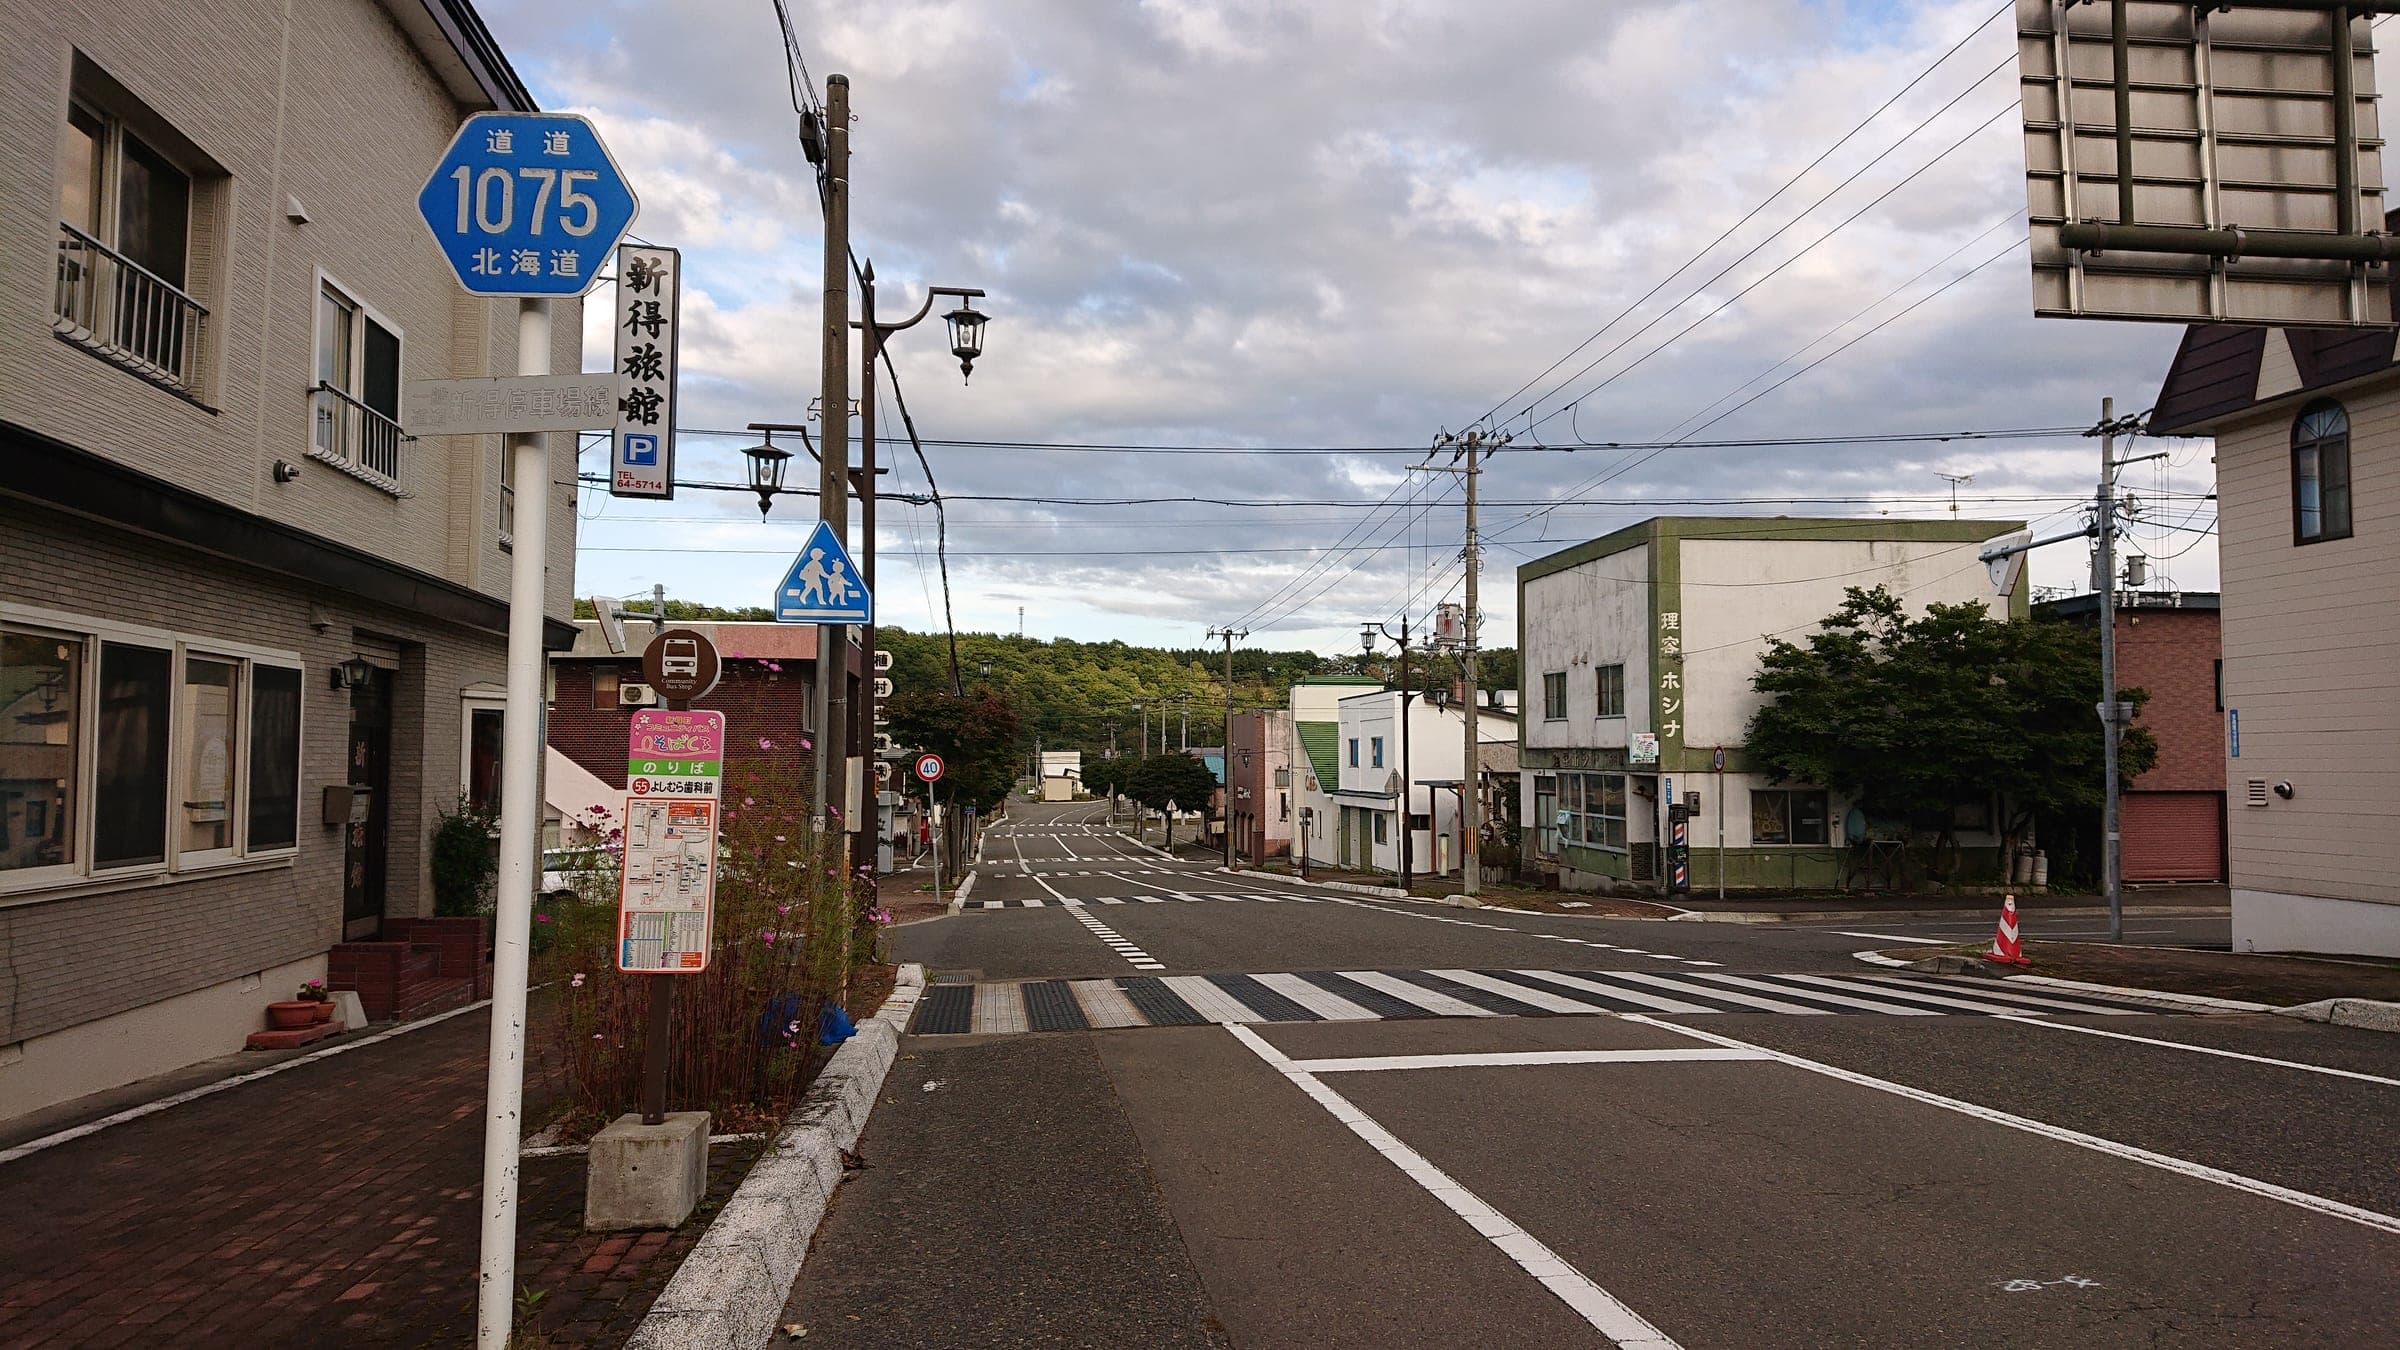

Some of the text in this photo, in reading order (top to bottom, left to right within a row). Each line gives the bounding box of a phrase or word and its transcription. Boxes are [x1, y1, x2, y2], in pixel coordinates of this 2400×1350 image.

[486, 129, 570, 156] 道道
[450, 165, 599, 237] 1075
[471, 247, 579, 277] 北海道
[621, 256, 668, 427] 新得旅館
[629, 438, 653, 461] P
[617, 471, 635, 480] TEL
[616, 479, 663, 491] 64-5714
[1660, 612, 1681, 738] 理容 ホシナ
[1715, 751, 1723, 766] 40
[643, 761, 704, 775] のりば
[922, 761, 938, 774] 40
[634, 780, 648, 792] 55
[650, 780, 714, 795] よしむら歯科前
